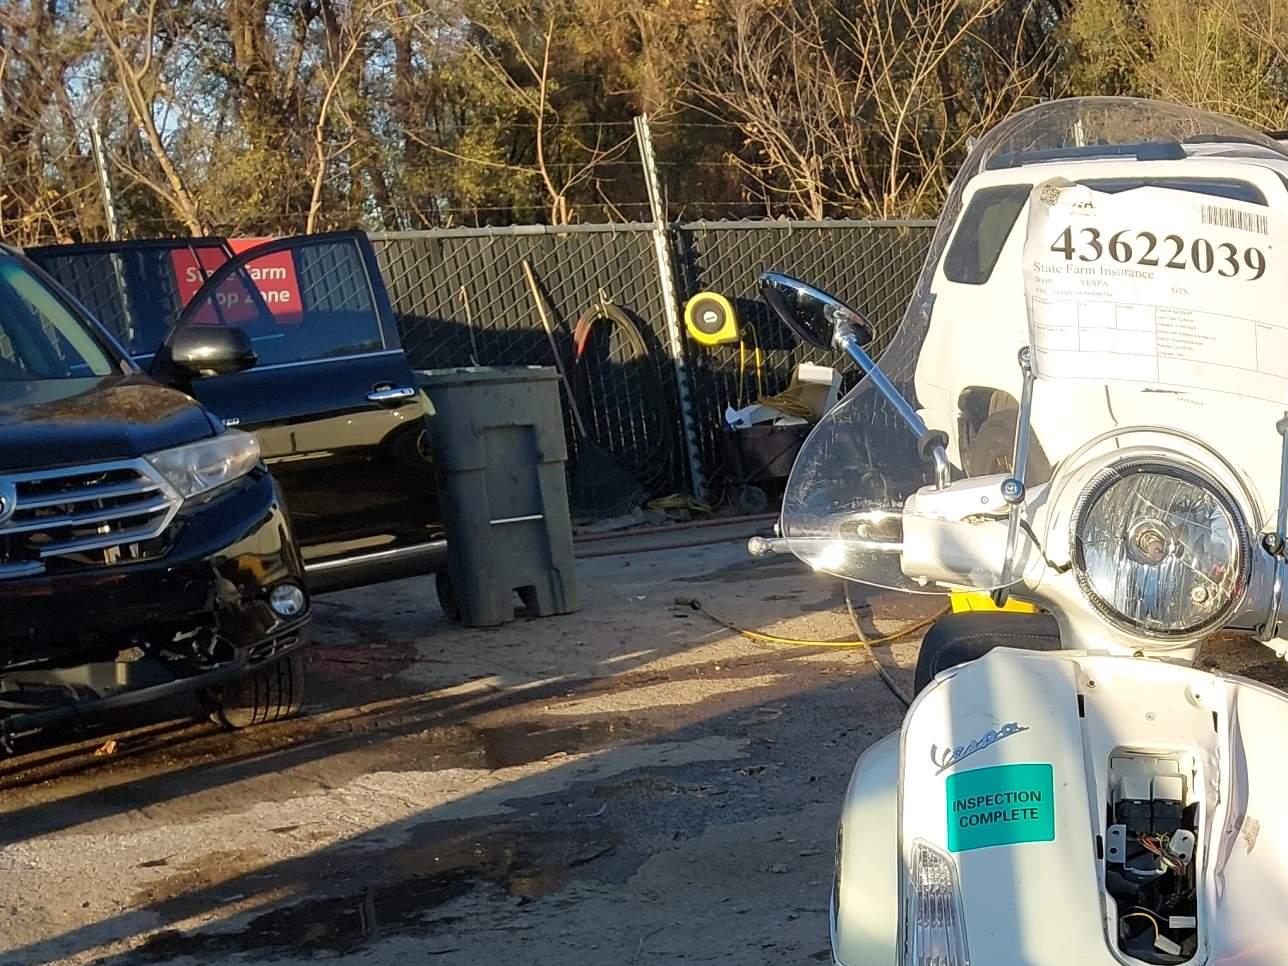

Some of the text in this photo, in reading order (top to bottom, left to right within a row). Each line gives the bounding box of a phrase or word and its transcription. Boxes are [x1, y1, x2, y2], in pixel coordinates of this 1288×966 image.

[1050, 224, 1266, 281] 43622039
[1033, 261, 1155, 280] State Farm Insurance
[1080, 279, 1109, 288] VESPA
[930, 722, 1030, 776] Vespa
[953, 790, 1042, 812] INSPECTION
[959, 807, 1039, 828] COMPLETE
